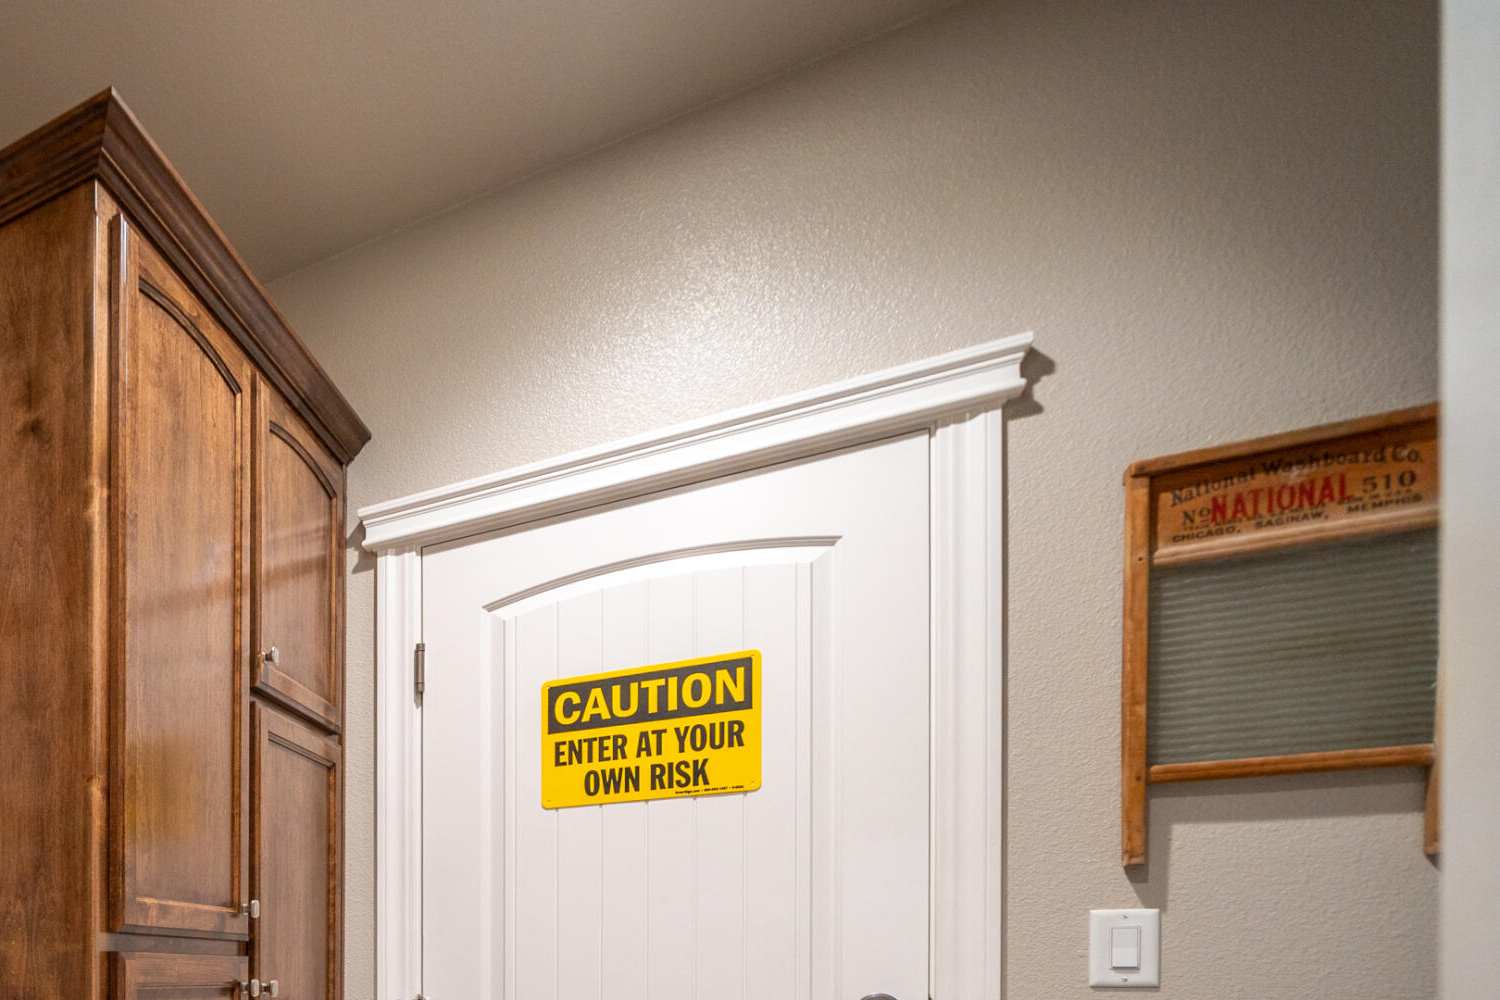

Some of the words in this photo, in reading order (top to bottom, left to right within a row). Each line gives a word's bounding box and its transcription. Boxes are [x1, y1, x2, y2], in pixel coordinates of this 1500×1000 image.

[1171, 465, 1256, 508] National
[1211, 473, 1354, 523] NATIONAL
[1361, 470, 1417, 494] 510
[554, 666, 745, 725] CAUTION
[554, 734, 628, 767] ENTER
[636, 729, 667, 758] AT
[674, 720, 745, 754] YOUR
[584, 766, 640, 797] OWN
[650, 758, 710, 791] RISK
